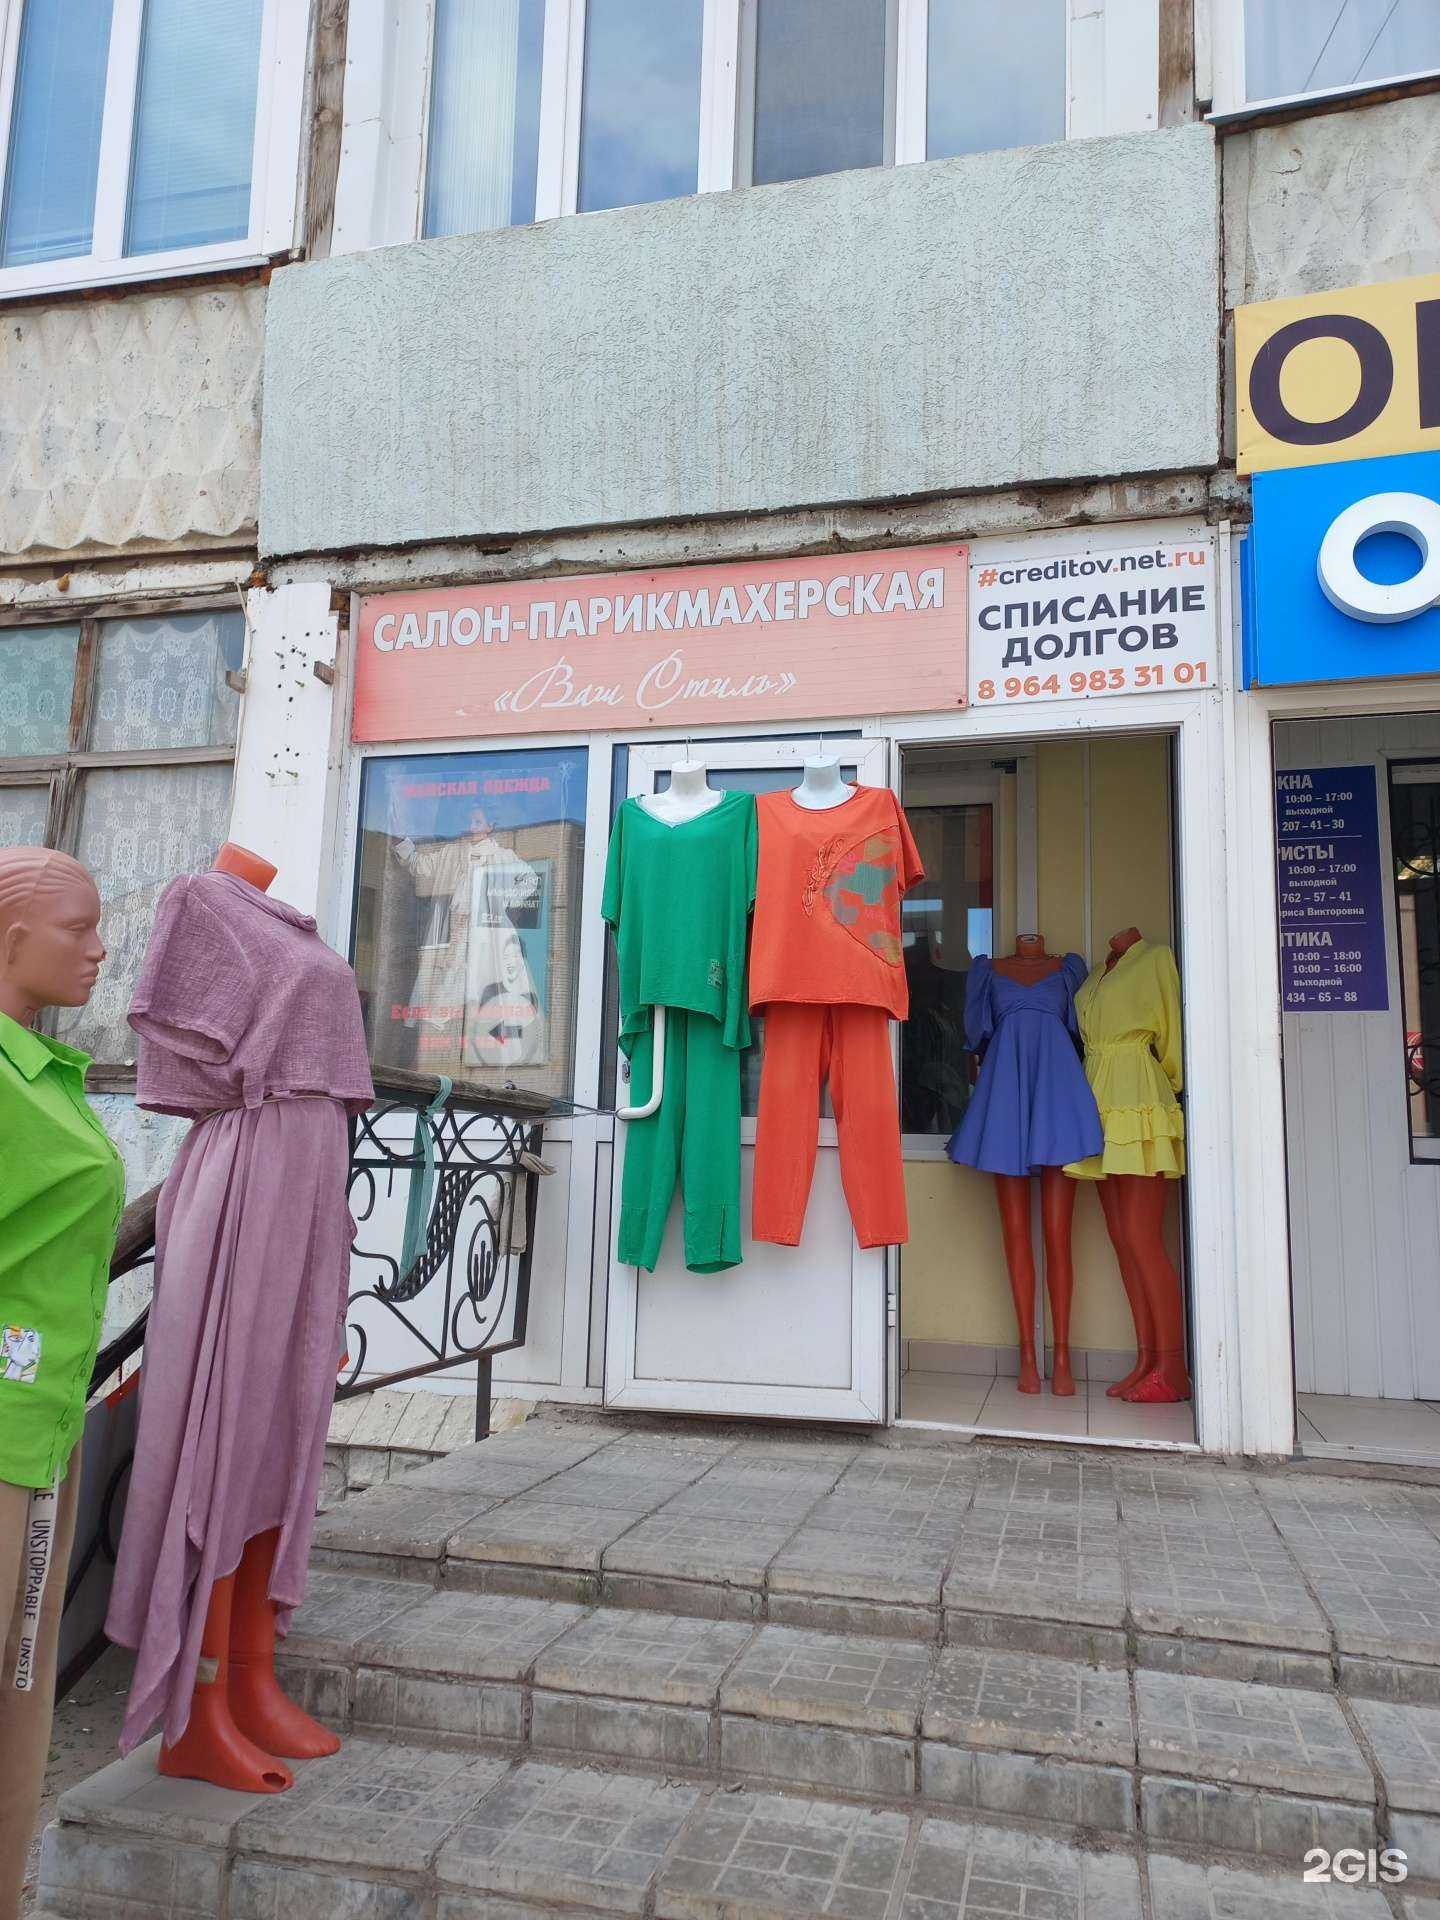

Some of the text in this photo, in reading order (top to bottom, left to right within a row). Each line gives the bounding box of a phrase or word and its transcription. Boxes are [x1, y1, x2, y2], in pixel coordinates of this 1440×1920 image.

[978, 550, 1206, 588] #creditov.net.ru
[373, 567, 945, 652] САЛОН-ПАРИКМАХЕРСКАЯ
[978, 585, 1206, 631] СПИСАНИЕ
[1001, 622, 1179, 668] ДОЛГОВ
[978, 661, 1208, 700] 8 964 983 31 01
[1285, 794, 1312, 804] 10:00
[1325, 792, 1353, 802] 17:00
[1285, 806, 1334, 817] выходной
[1277, 844, 1334, 860] ИСТЫ
[1288, 865, 1316, 875] 10:00
[1329, 864, 1357, 873] 17:00
[1289, 877, 1337, 888] выходной
[1307, 907, 1364, 917] Викторовна
[1292, 952, 1320, 961] 10:00
[1333, 951, 1361, 961] 18:00
[1292, 964, 1320, 974] 10:00
[1334, 964, 1362, 973] 16:00
[1293, 977, 1343, 988] выходной
[24, 1519, 52, 1621] UNSTOPPABLE
